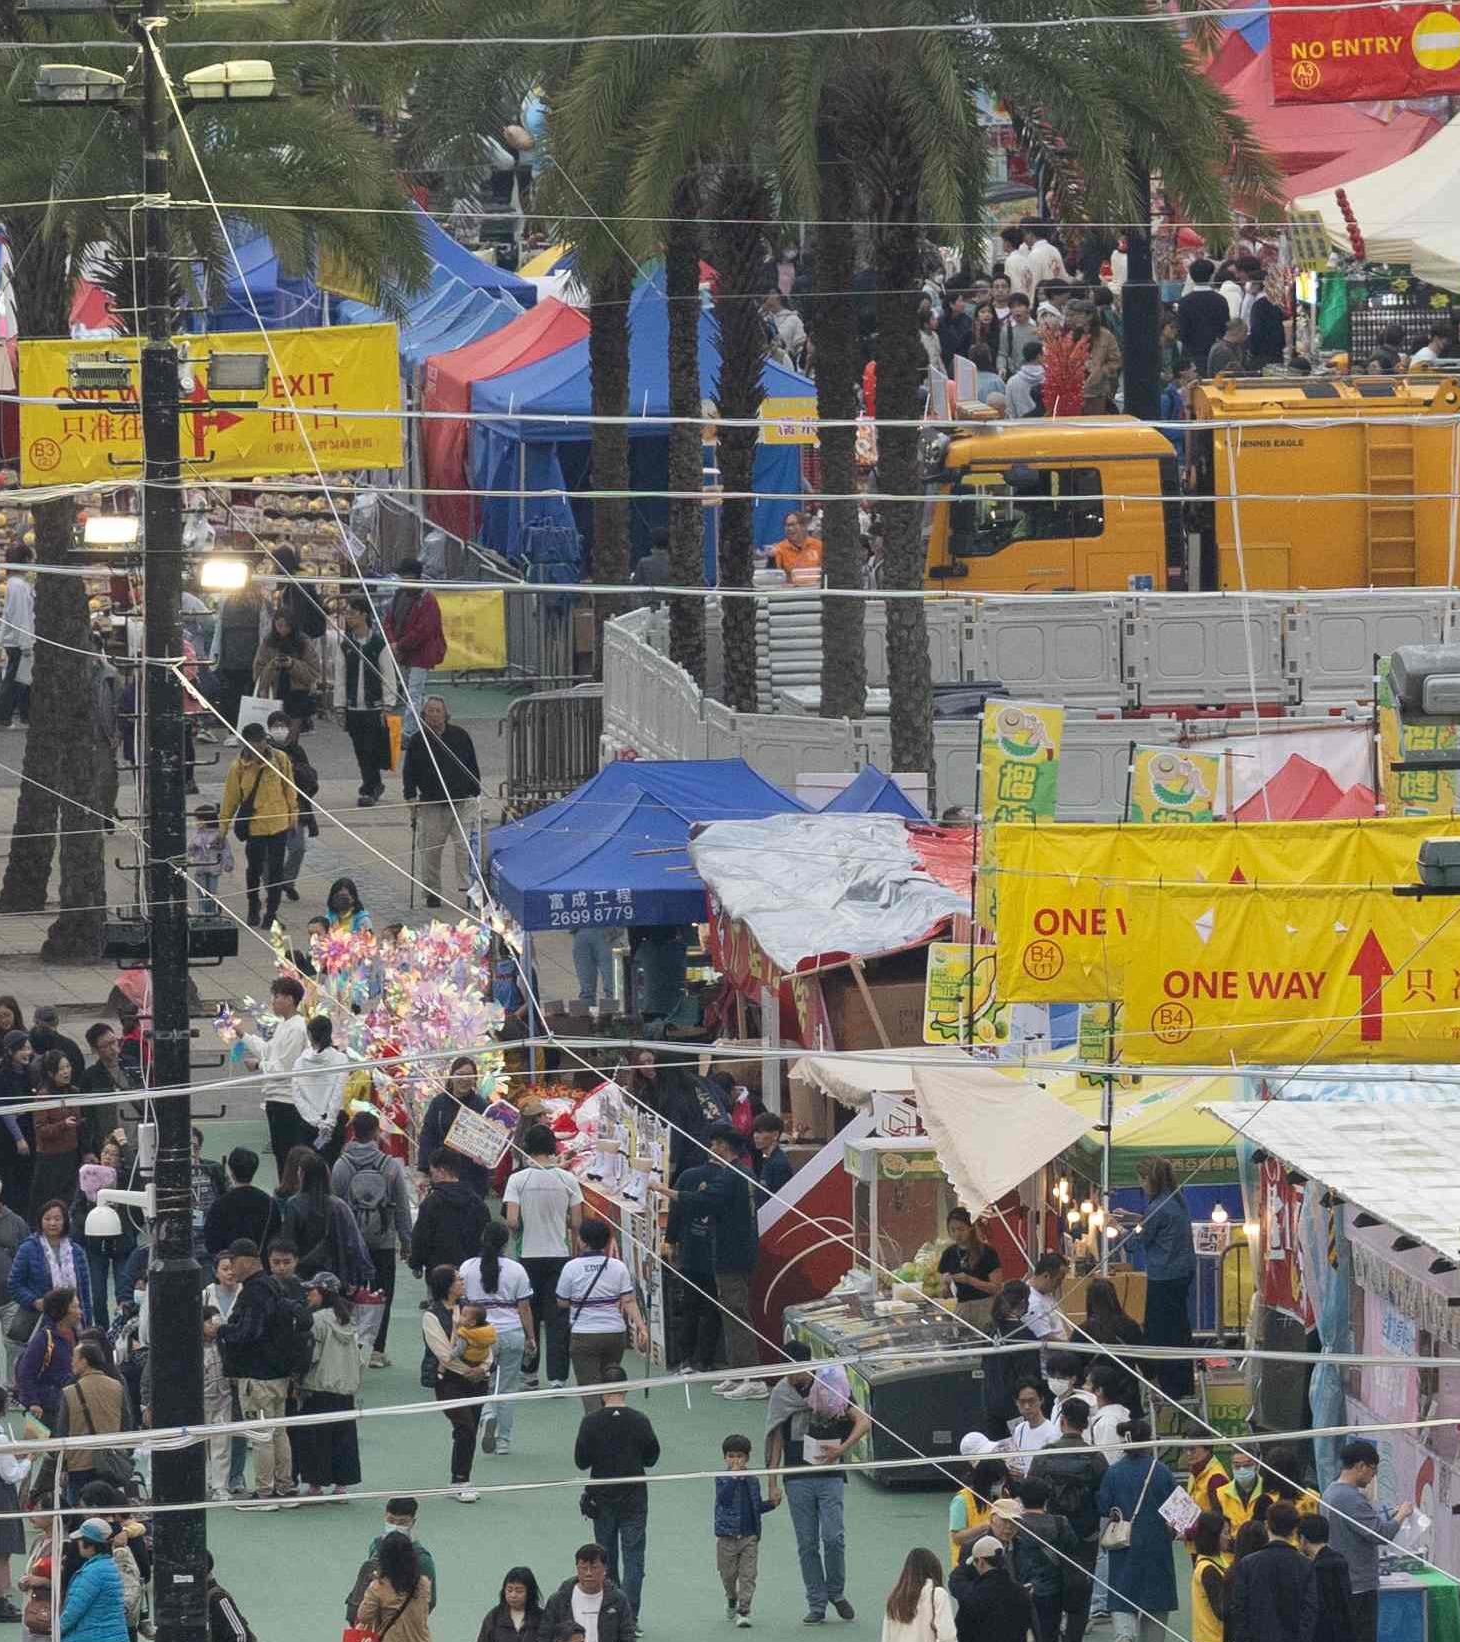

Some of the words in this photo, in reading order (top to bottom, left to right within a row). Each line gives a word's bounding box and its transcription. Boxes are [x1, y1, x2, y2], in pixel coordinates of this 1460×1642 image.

[1291, 42, 1316, 59] NO
[1321, 36, 1402, 57] ENTRY
[273, 371, 334, 399] EXIT
[272, 402, 338, 435] 出口
[35, 442, 57, 459] B3
[548, 887, 634, 910] 富成工程
[552, 909, 591, 926] 2699
[594, 905, 634, 921] 8779
[1034, 907, 1107, 937] ONE
[1030, 943, 1057, 961] B4
[1163, 970, 1238, 1000] ONE
[1247, 970, 1327, 1000] WAY
[1160, 1009, 1183, 1025] B4
